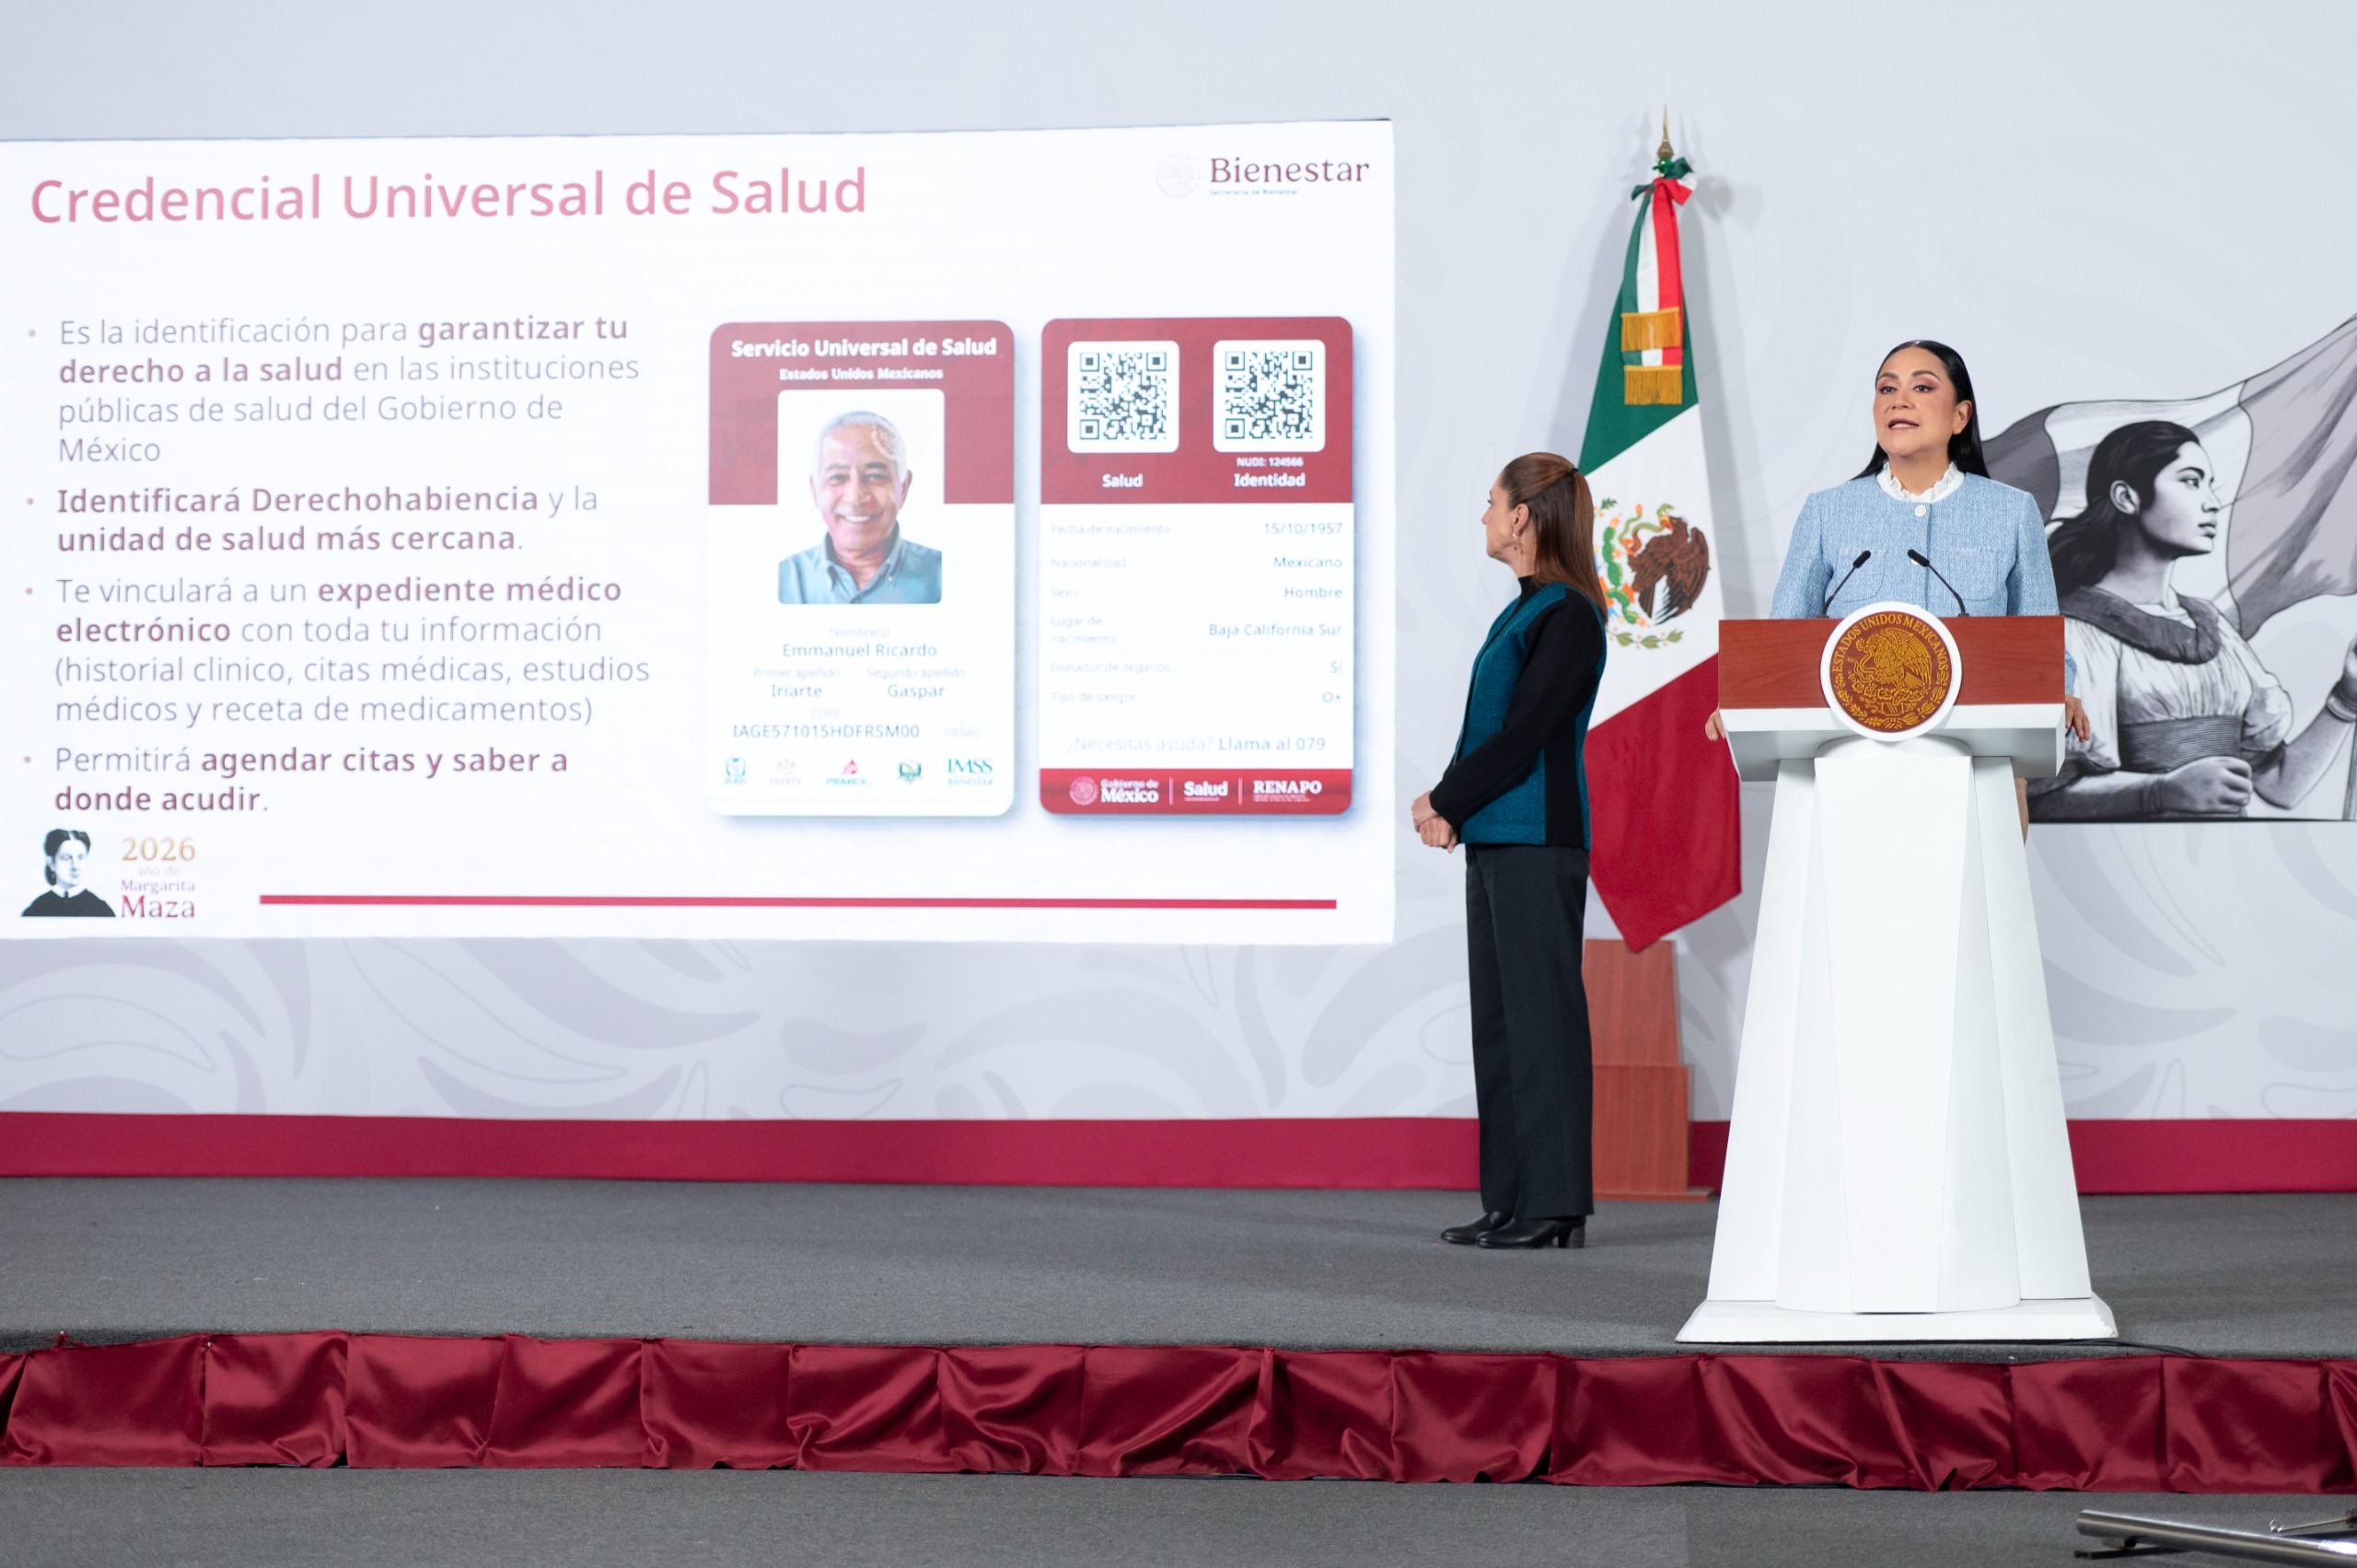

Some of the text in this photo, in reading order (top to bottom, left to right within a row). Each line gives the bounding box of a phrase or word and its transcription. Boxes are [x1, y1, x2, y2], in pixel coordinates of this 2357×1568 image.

[1210, 157, 1369, 183] Bienestar
[31, 164, 867, 223] Credencial Universal de Salud
[60, 317, 628, 349] Es la identificación para garantizar tu
[731, 338, 996, 356] Servicio Universal de Salud
[59, 355, 639, 383] derecho a la salud en las instituciones
[779, 368, 943, 380] Estados Unidos Mexicanos
[59, 394, 563, 430] públicas de salud del Gobierno de
[59, 436, 161, 462] México
[1102, 473, 1143, 488] Salud
[1234, 473, 1306, 487] Identidad
[58, 486, 597, 518] Identificará Derechohabiencia y la
[1265, 523, 1341, 535] 15/10/1957
[58, 526, 523, 552] unidad de salud más cercana.
[1273, 557, 1341, 568] Mexicano
[56, 577, 621, 610] Te vinculará a un expediente médico
[1284, 587, 1341, 598] Hombre
[57, 616, 601, 644] electrónico con toda tu información
[1209, 624, 1341, 639] Baja California Sur
[783, 644, 937, 656] Emmanuel Ricardo
[1832, 613, 1949, 672] ESTADOS UNIDOS MEXICANOS
[56, 656, 649, 686] (historial clinico, citas médicas, estudios
[753, 668, 790, 678] Primer
[866, 668, 916, 680] Segundo
[772, 685, 822, 698] Iriarte
[888, 685, 945, 701] Gaspar
[56, 696, 592, 728] médicos y receta de medicamentos)
[810, 708, 842, 718] CURP
[1066, 738, 1213, 753] ¿Necesitas ayuda?
[1219, 738, 1325, 750] Llama al 079
[56, 747, 567, 778] Permitirá agendar citas y saber a
[947, 759, 993, 773] IMSS
[1100, 785, 1159, 803] México
[1183, 782, 1228, 796] Salud
[1253, 781, 1322, 795] RENAPO
[55, 788, 267, 811] donde acudir.
[122, 838, 195, 861] 2026
[137, 865, 180, 876] año de
[121, 879, 195, 894] Margarita
[121, 895, 195, 918] Maza
